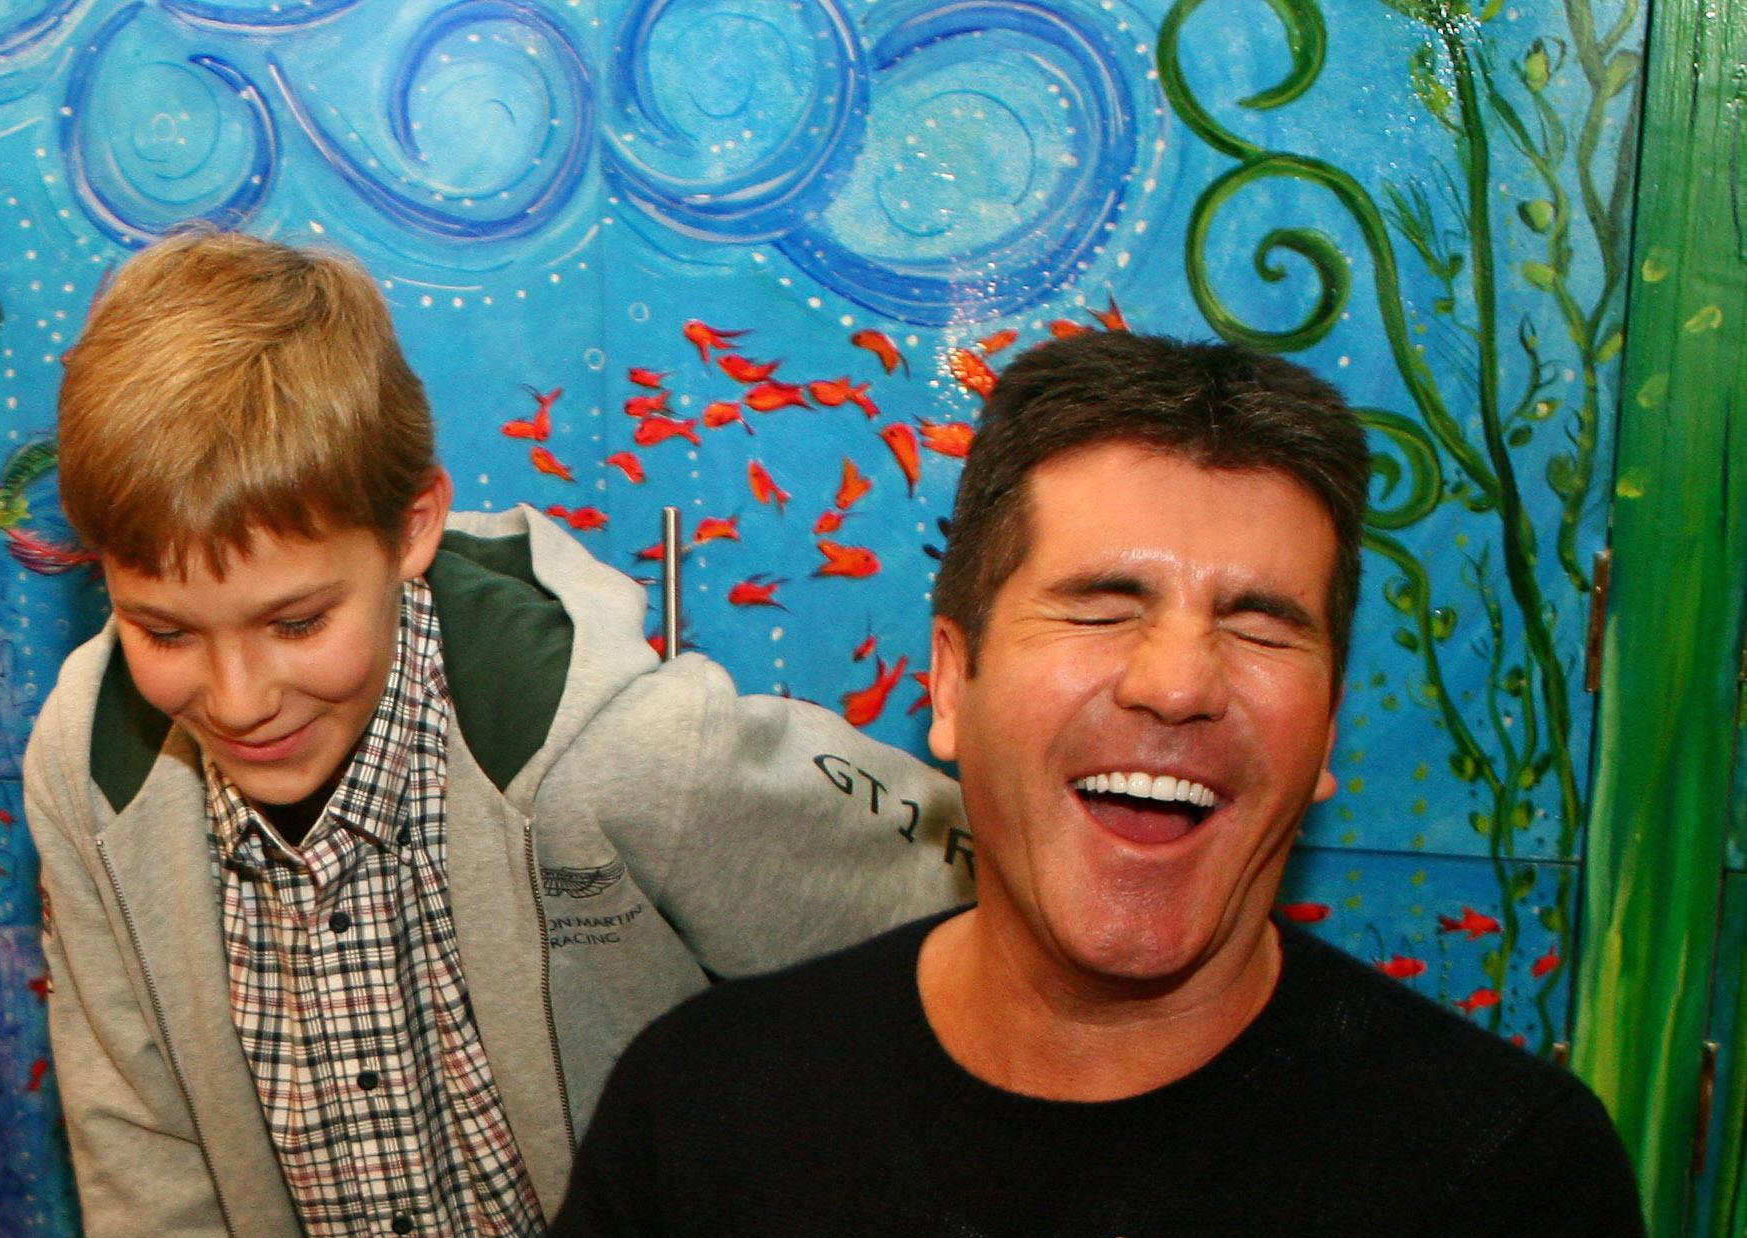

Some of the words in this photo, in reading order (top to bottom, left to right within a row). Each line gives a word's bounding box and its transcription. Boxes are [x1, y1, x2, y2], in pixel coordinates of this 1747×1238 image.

[944, 826, 976, 881] R
[575, 904, 642, 927] MARTIN
[549, 932, 621, 949] RACING
